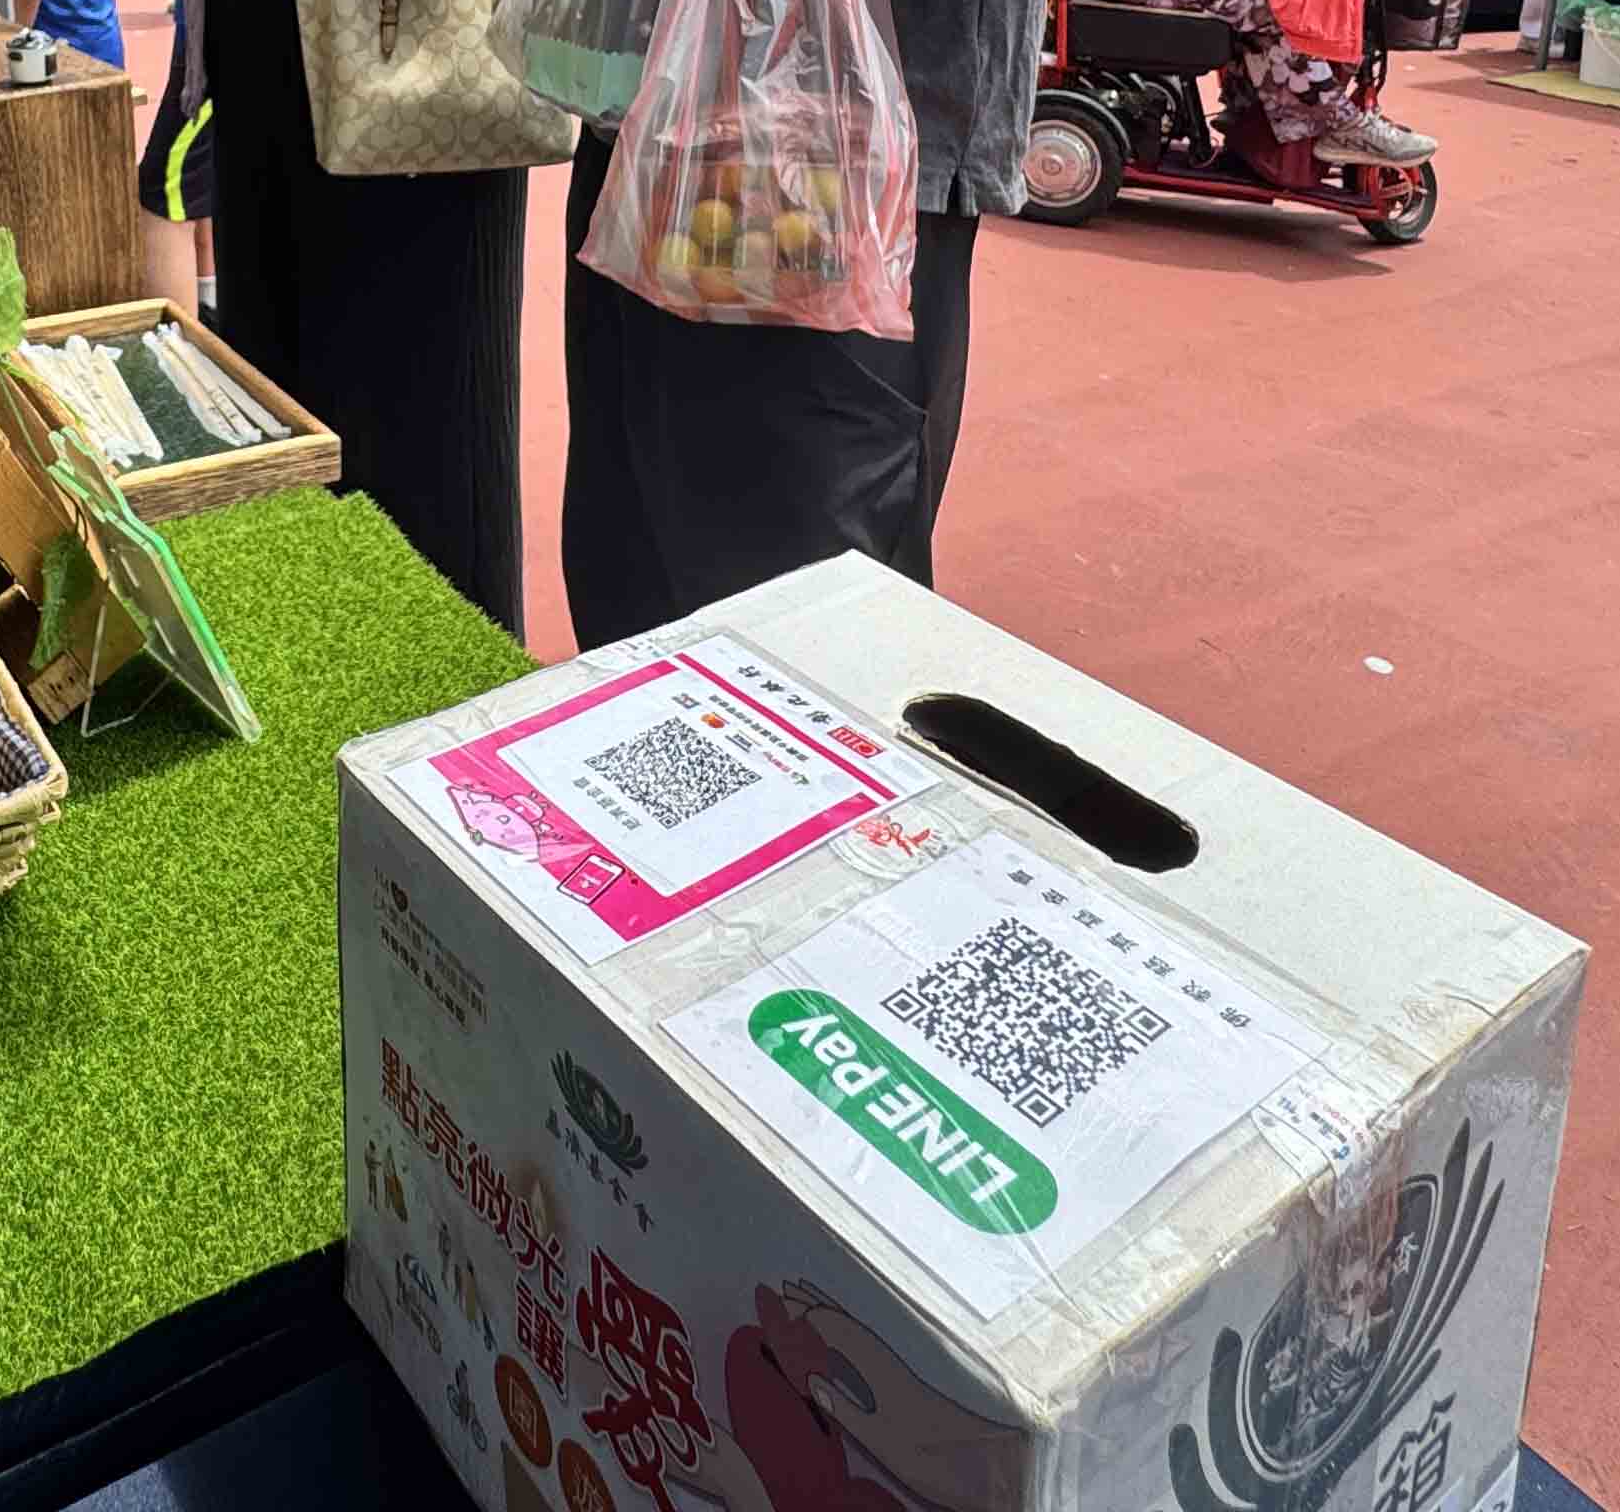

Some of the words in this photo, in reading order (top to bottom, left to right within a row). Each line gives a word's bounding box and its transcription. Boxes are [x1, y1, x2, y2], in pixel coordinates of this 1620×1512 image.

[782, 1012, 889, 1098] Pay
[381, 1036, 568, 1312] 點亮微光
[865, 1085, 1020, 1204] LINE
[514, 1276, 567, 1399] 讓
